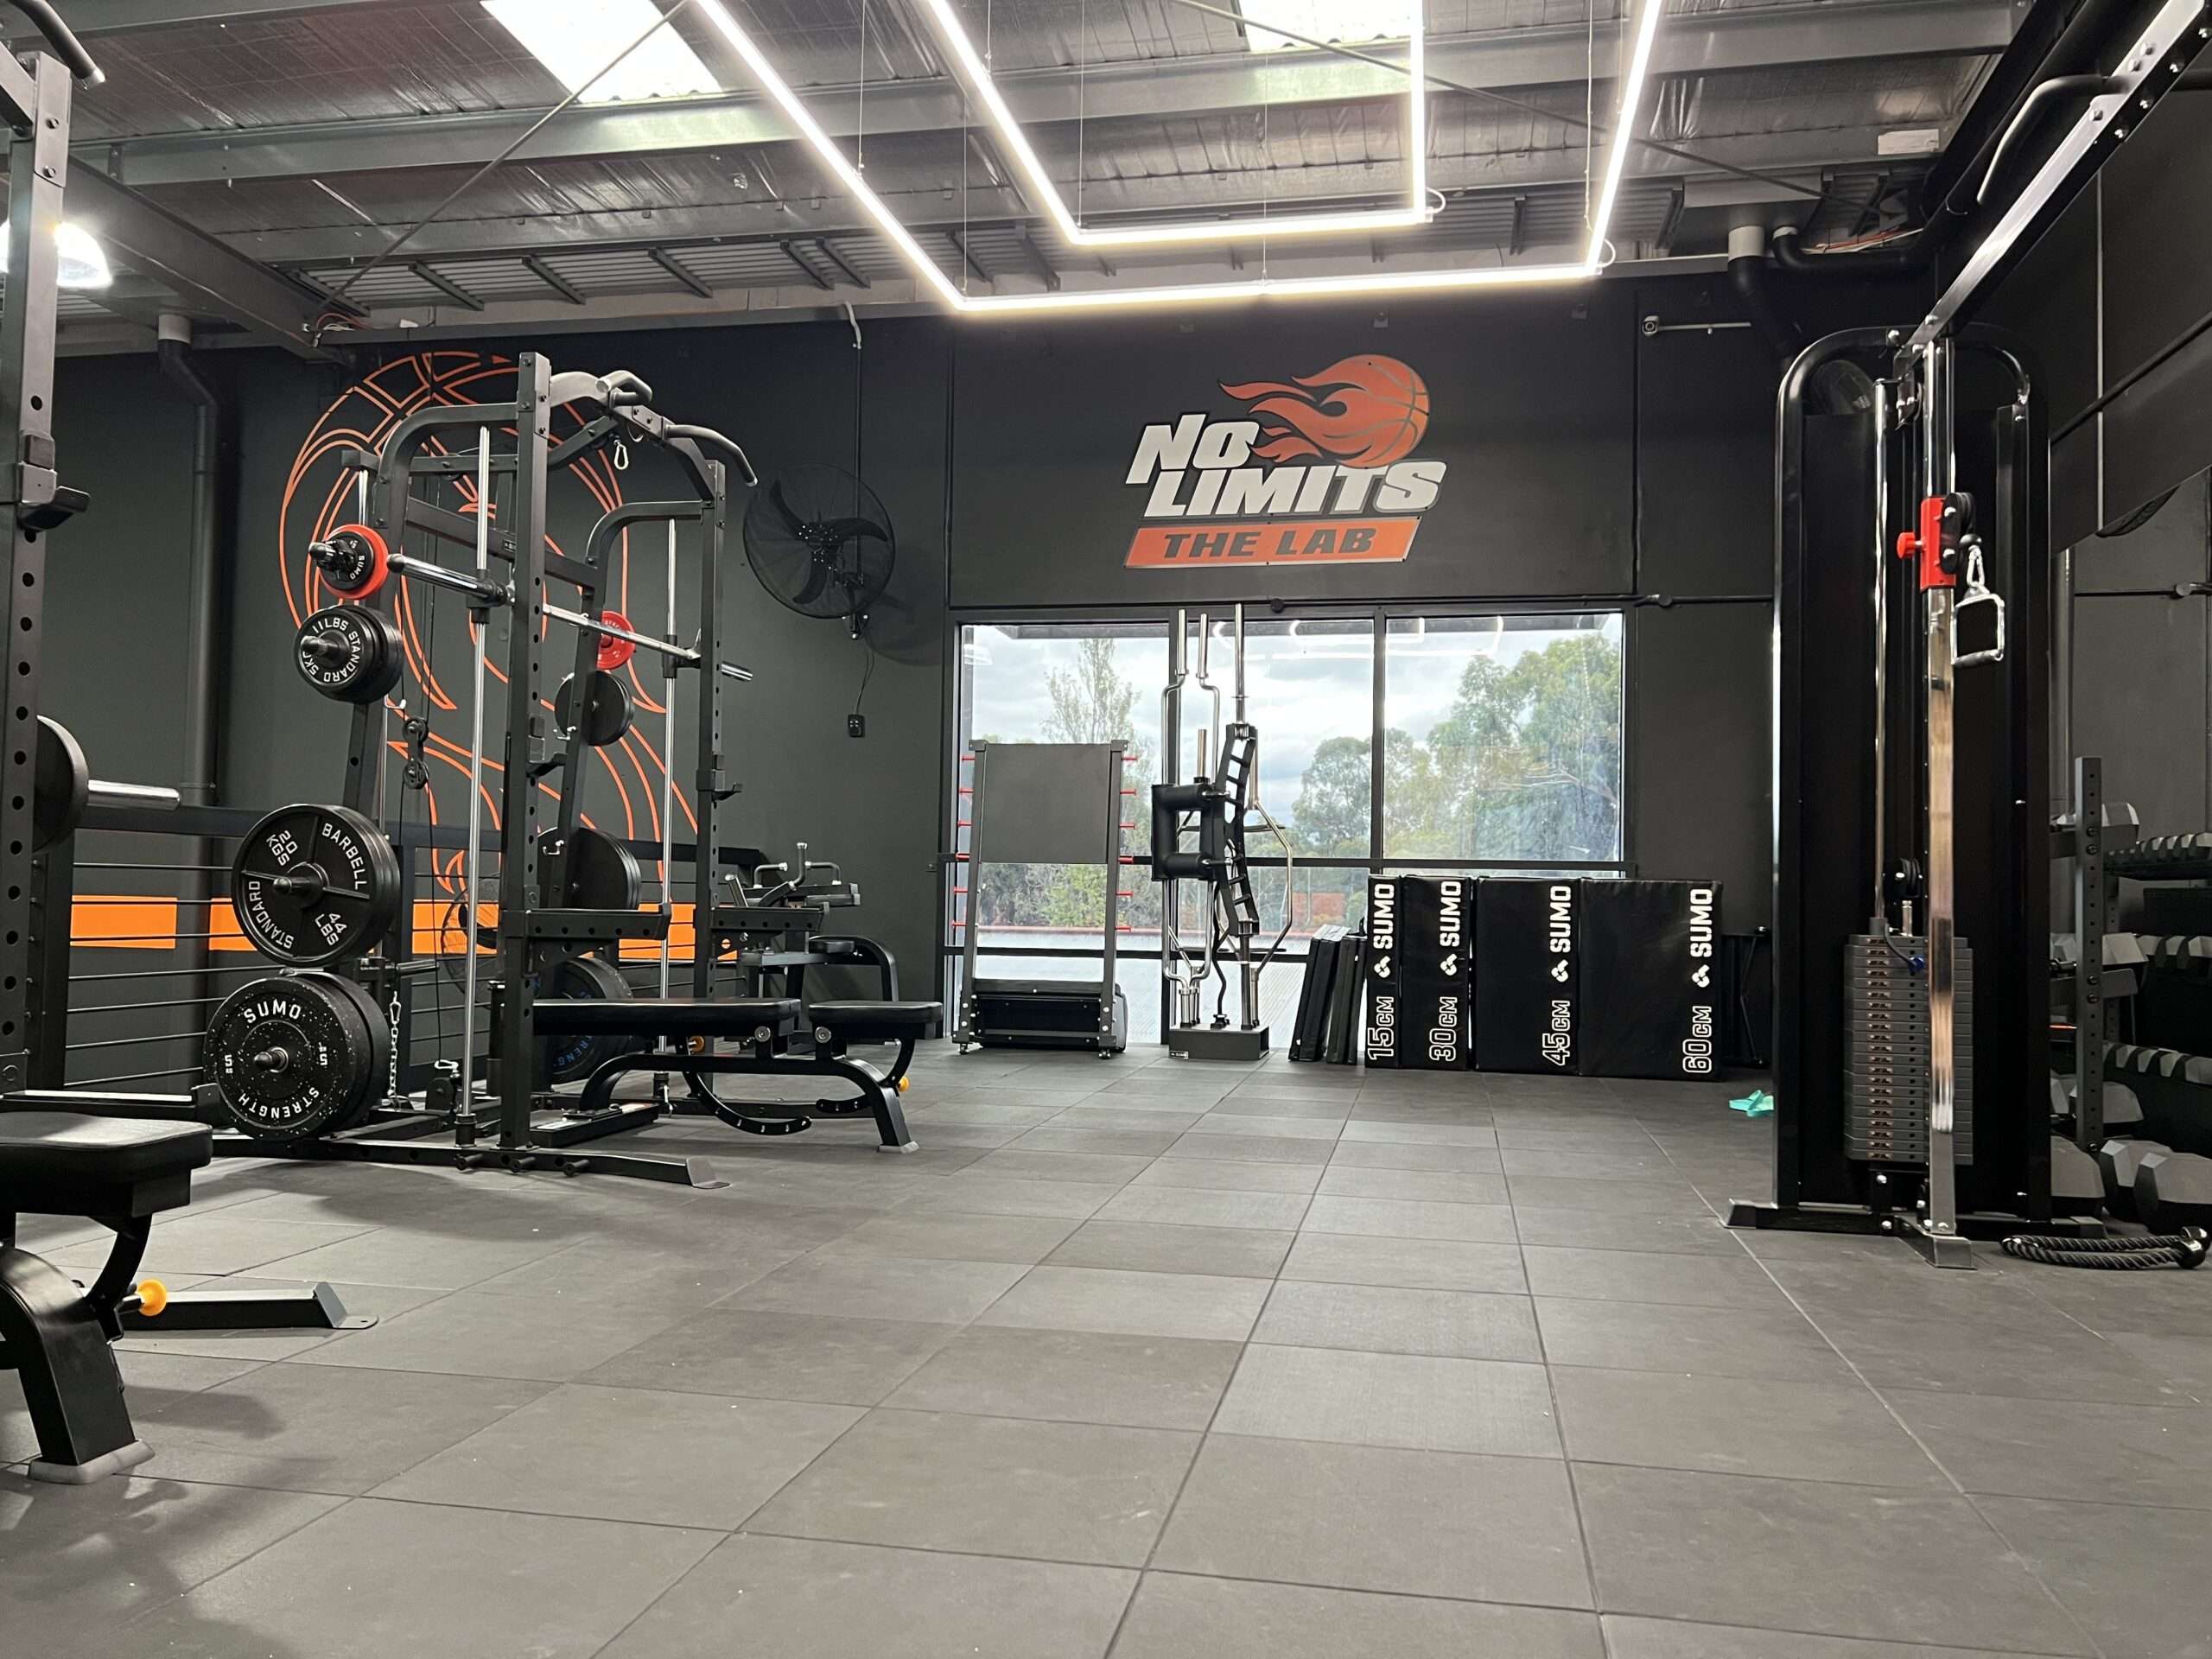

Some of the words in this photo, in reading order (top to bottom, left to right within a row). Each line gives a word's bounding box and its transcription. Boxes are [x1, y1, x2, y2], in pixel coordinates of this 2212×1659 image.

[1143, 461, 1446, 517] LIMITS
[349, 556, 365, 580] SUMO
[1164, 531, 1262, 558] THE
[1275, 528, 1376, 555] LAB
[323, 631, 361, 682] STANDARD
[266, 834, 290, 866] KGS
[278, 830, 298, 855] 20
[321, 823, 367, 890] BARBELL
[248, 880, 295, 949] STANDARD
[315, 913, 340, 946] LBS
[328, 913, 347, 934] 44
[1373, 883, 1395, 950] SUMO
[1440, 880, 1461, 947] SUMO
[1549, 886, 1571, 953] SUMO
[1689, 888, 1713, 957] SUMO
[244, 999, 302, 1023] SUMO
[1368, 996, 1395, 1060] 15CM
[1428, 996, 1458, 1062] 30CM
[1542, 1000, 1571, 1066] 45CM
[1682, 1005, 1713, 1073] 60CM
[238, 1087, 320, 1119] STRENGTH
